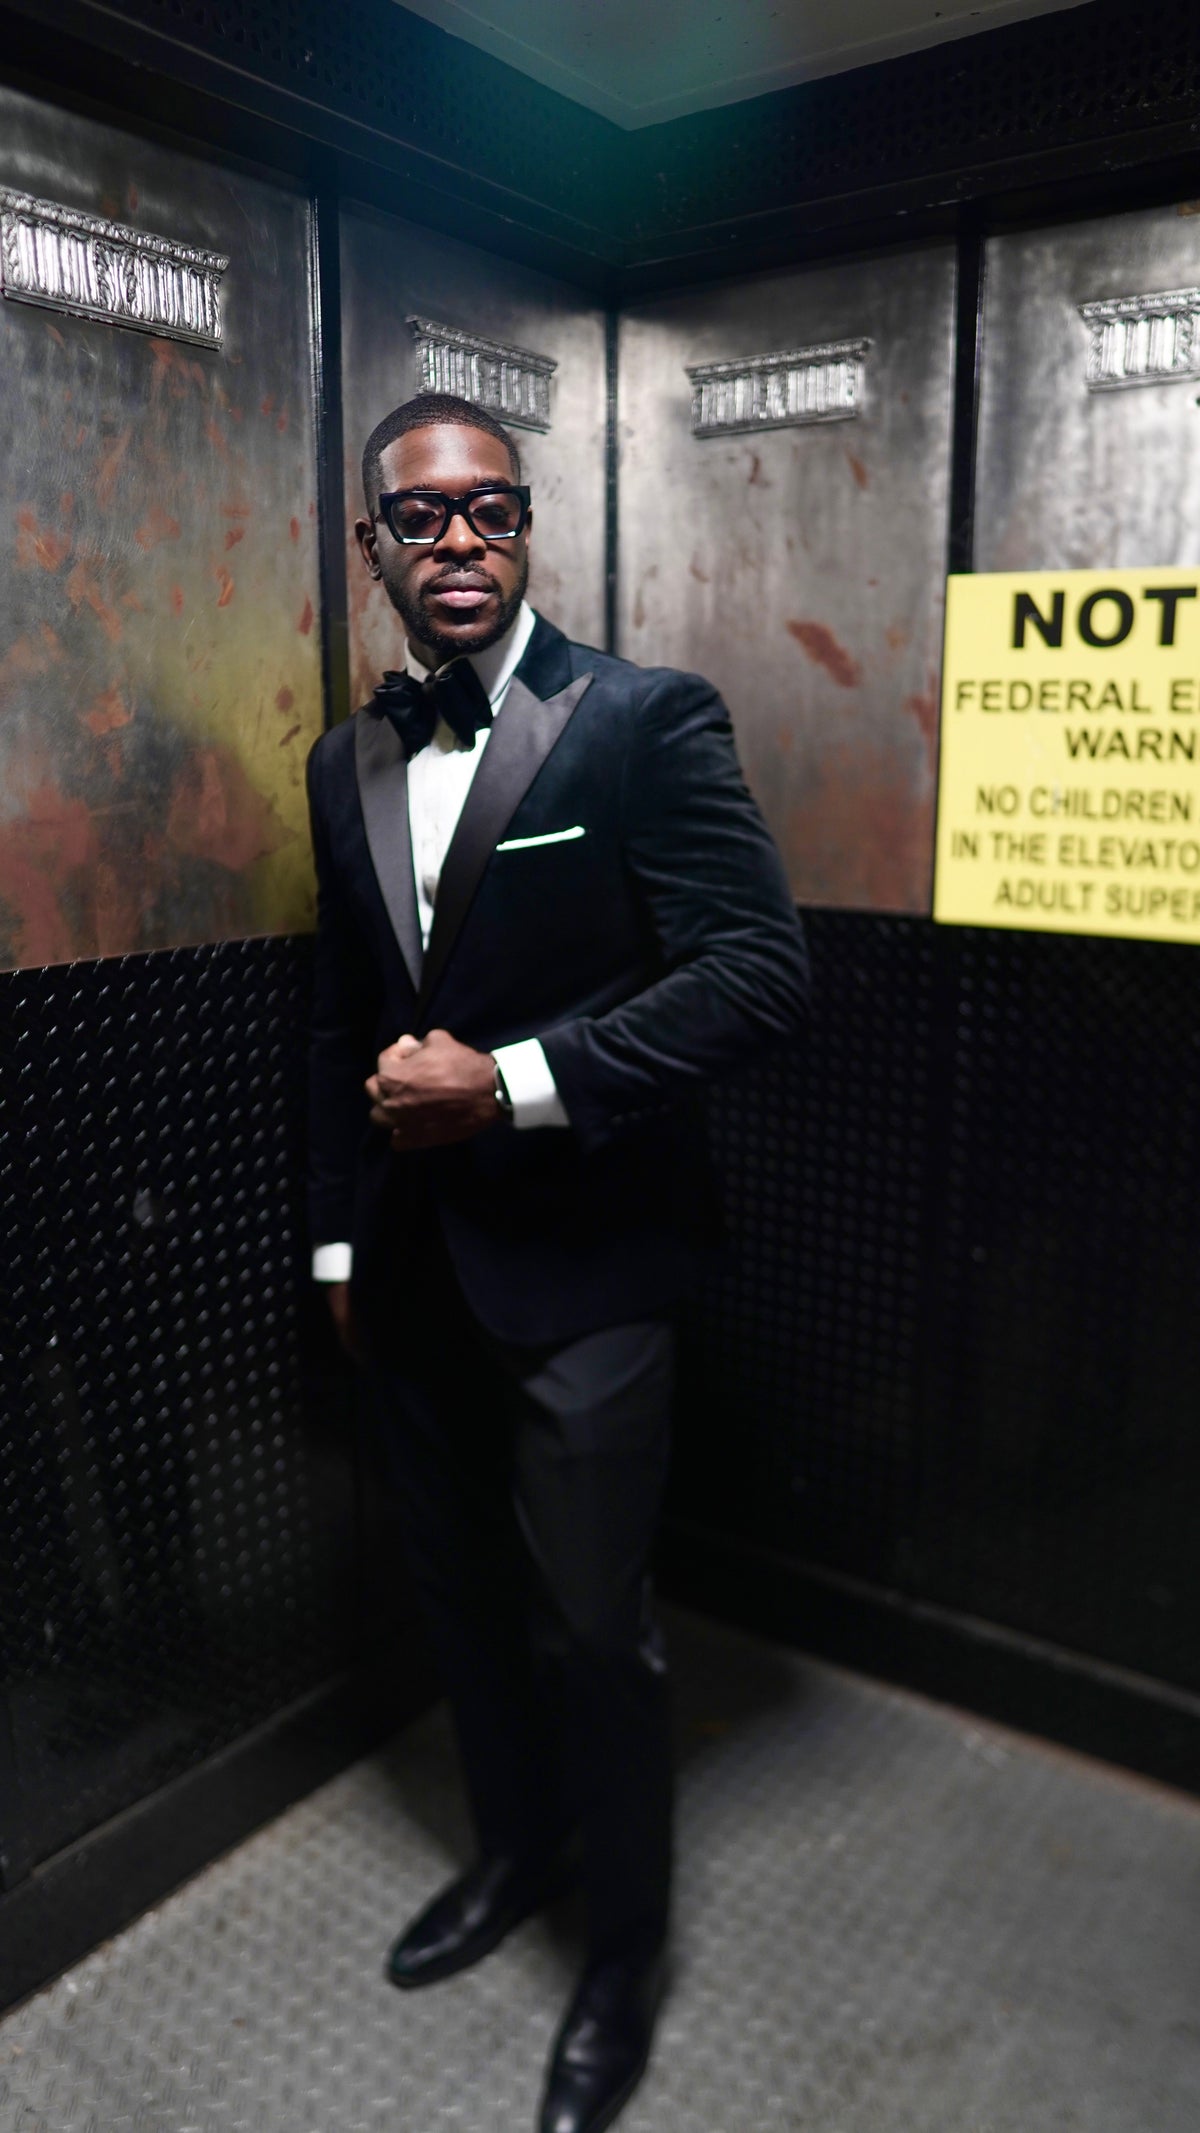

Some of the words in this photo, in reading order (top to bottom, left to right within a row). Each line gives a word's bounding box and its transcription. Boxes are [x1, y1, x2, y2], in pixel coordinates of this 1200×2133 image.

[1012, 587, 1197, 649] NOT
[955, 679, 1151, 713] FEDERAL
[1169, 678, 1200, 714] E
[976, 784, 1020, 817] NO
[1029, 785, 1191, 823] CHILDREN
[951, 828, 978, 860] IN
[989, 830, 1047, 865] THE
[1058, 834, 1200, 873] ELEVATO
[994, 878, 1096, 915] ADULT
